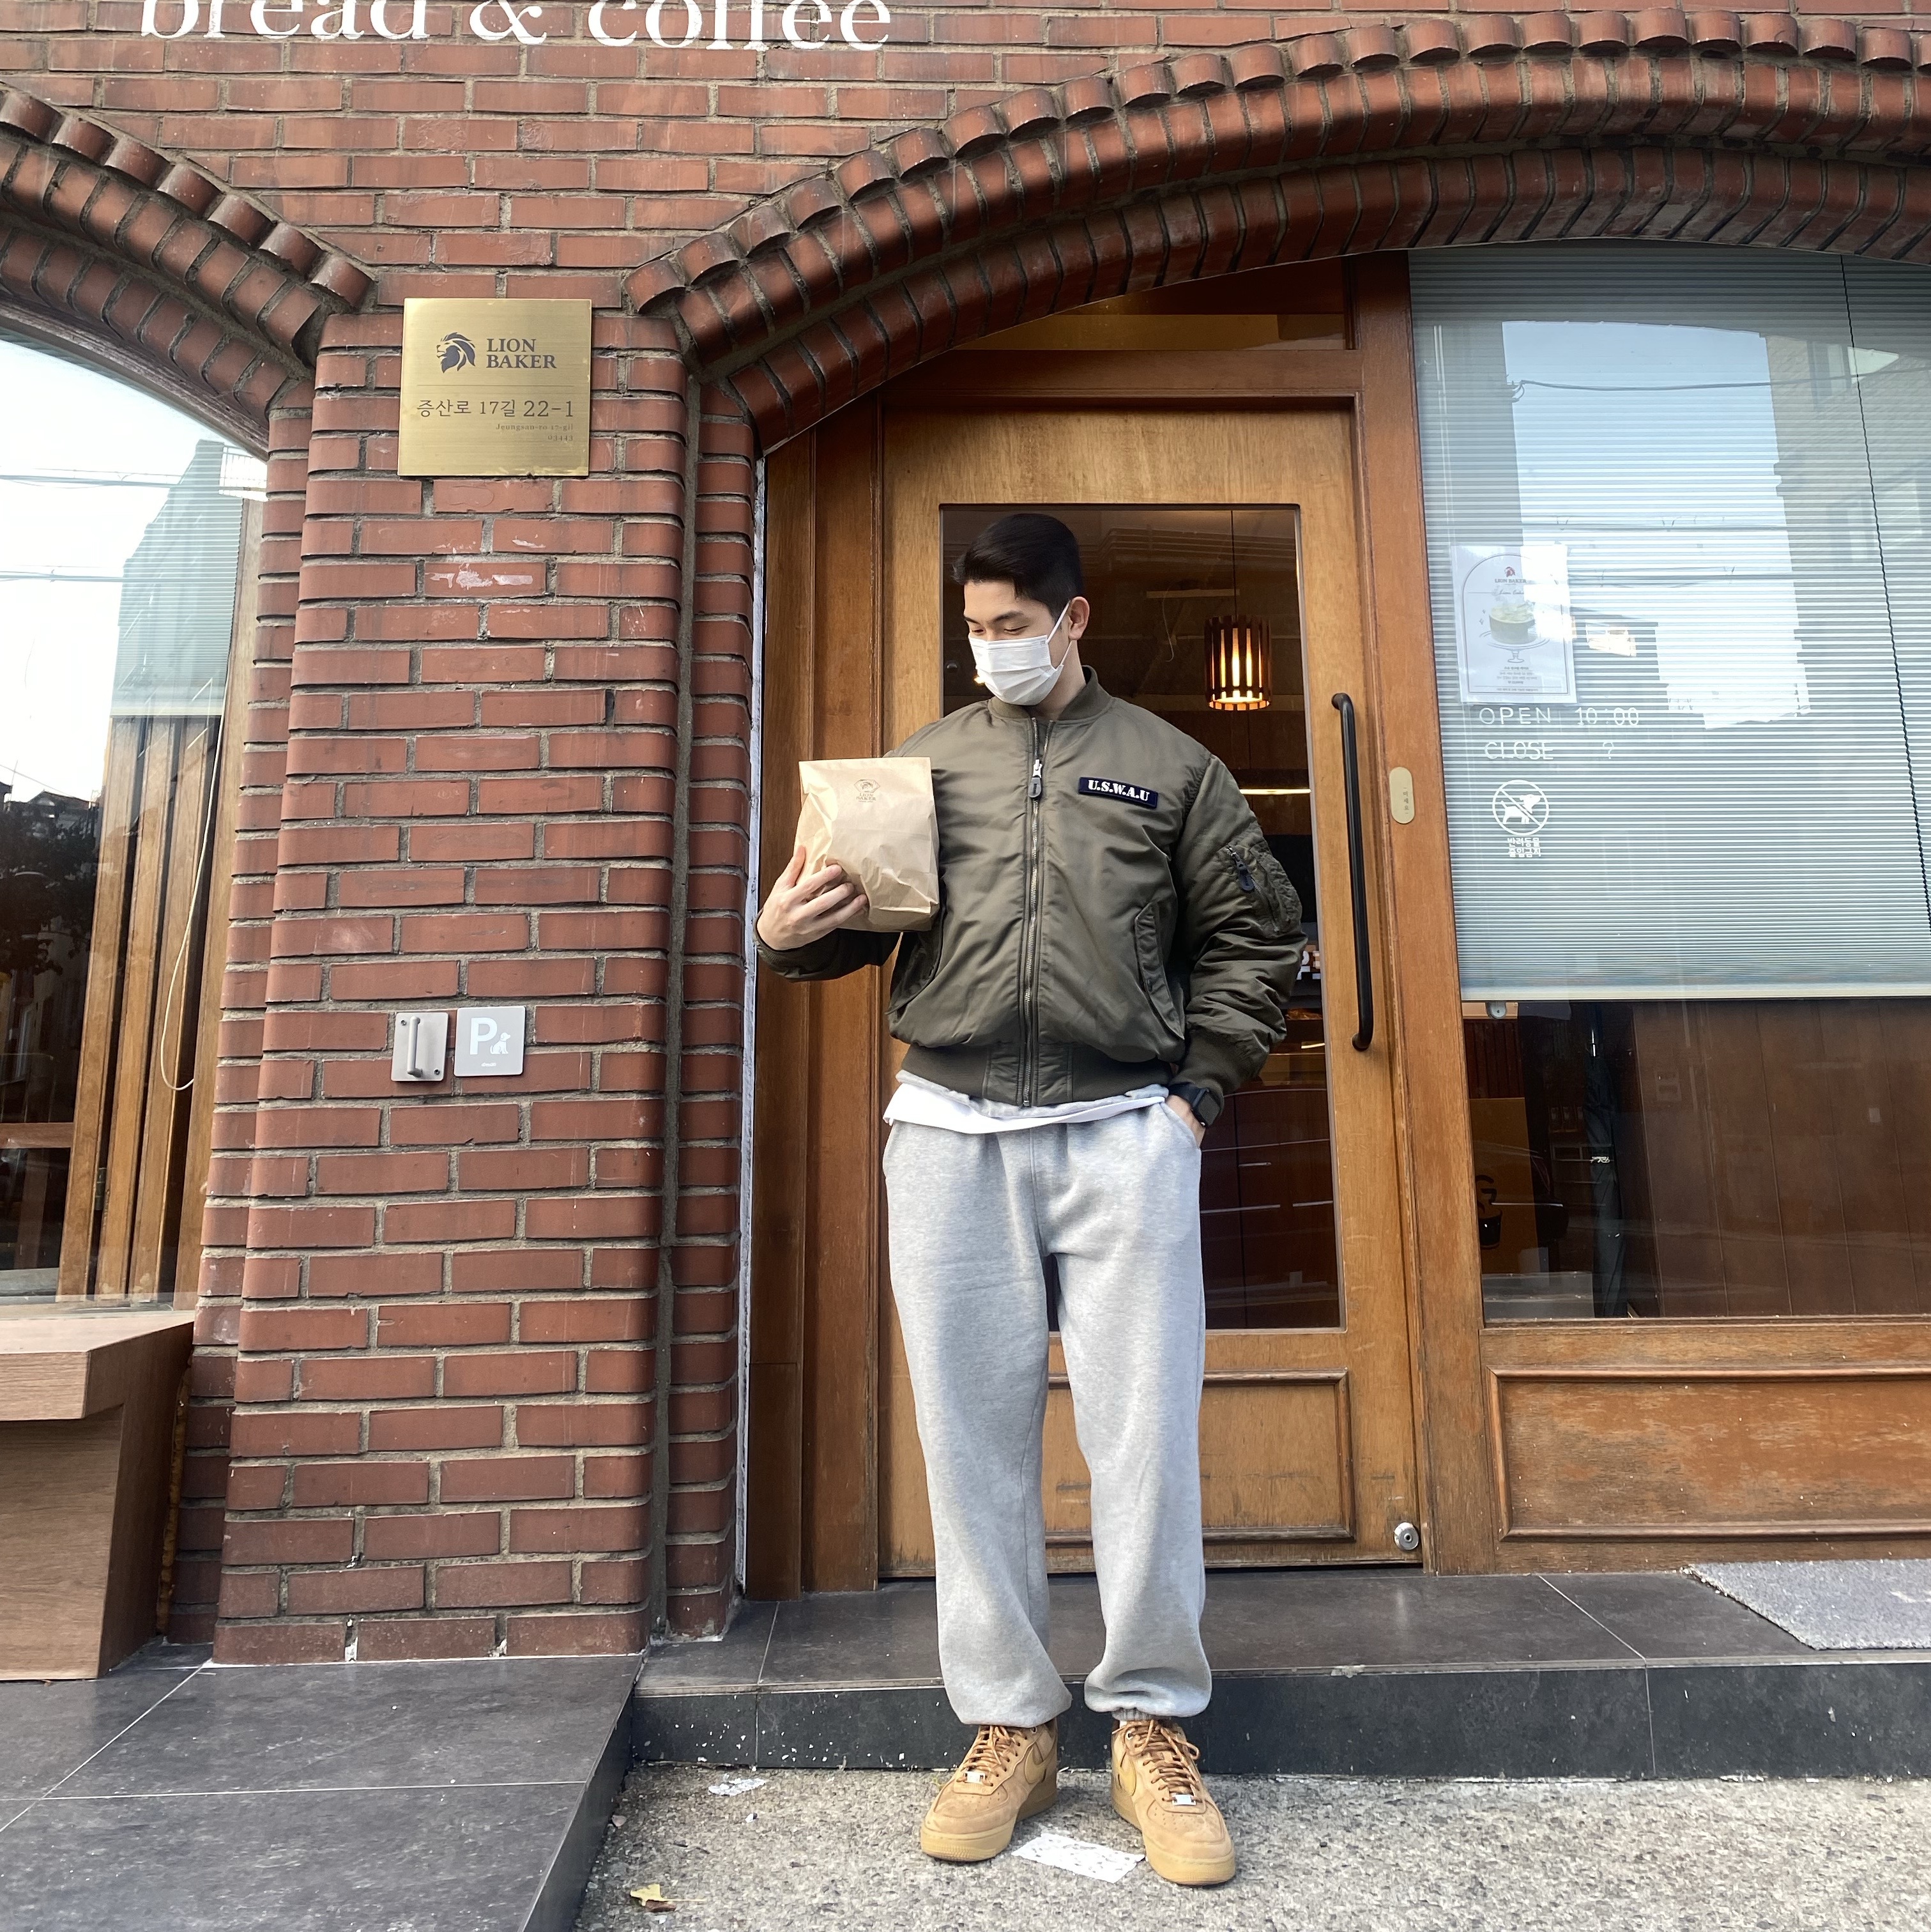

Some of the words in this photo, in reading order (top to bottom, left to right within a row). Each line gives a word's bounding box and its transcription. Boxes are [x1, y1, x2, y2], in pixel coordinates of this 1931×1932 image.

[487, 338, 537, 352] LION
[486, 354, 558, 369] BAKER
[416, 399, 472, 417] 증산로
[480, 399, 515, 417] 17길
[523, 400, 574, 417] 22-1
[496, 423, 548, 432] Jeungsan-ro
[1479, 707, 1551, 724] OPEN
[1484, 741, 1554, 760] CLOSE
[1088, 779, 1150, 801] U.S.W.A.U
[1507, 837, 1541, 847] 반려동물
[1507, 847, 1541, 858] 출입금지
[469, 1017, 498, 1055] P
